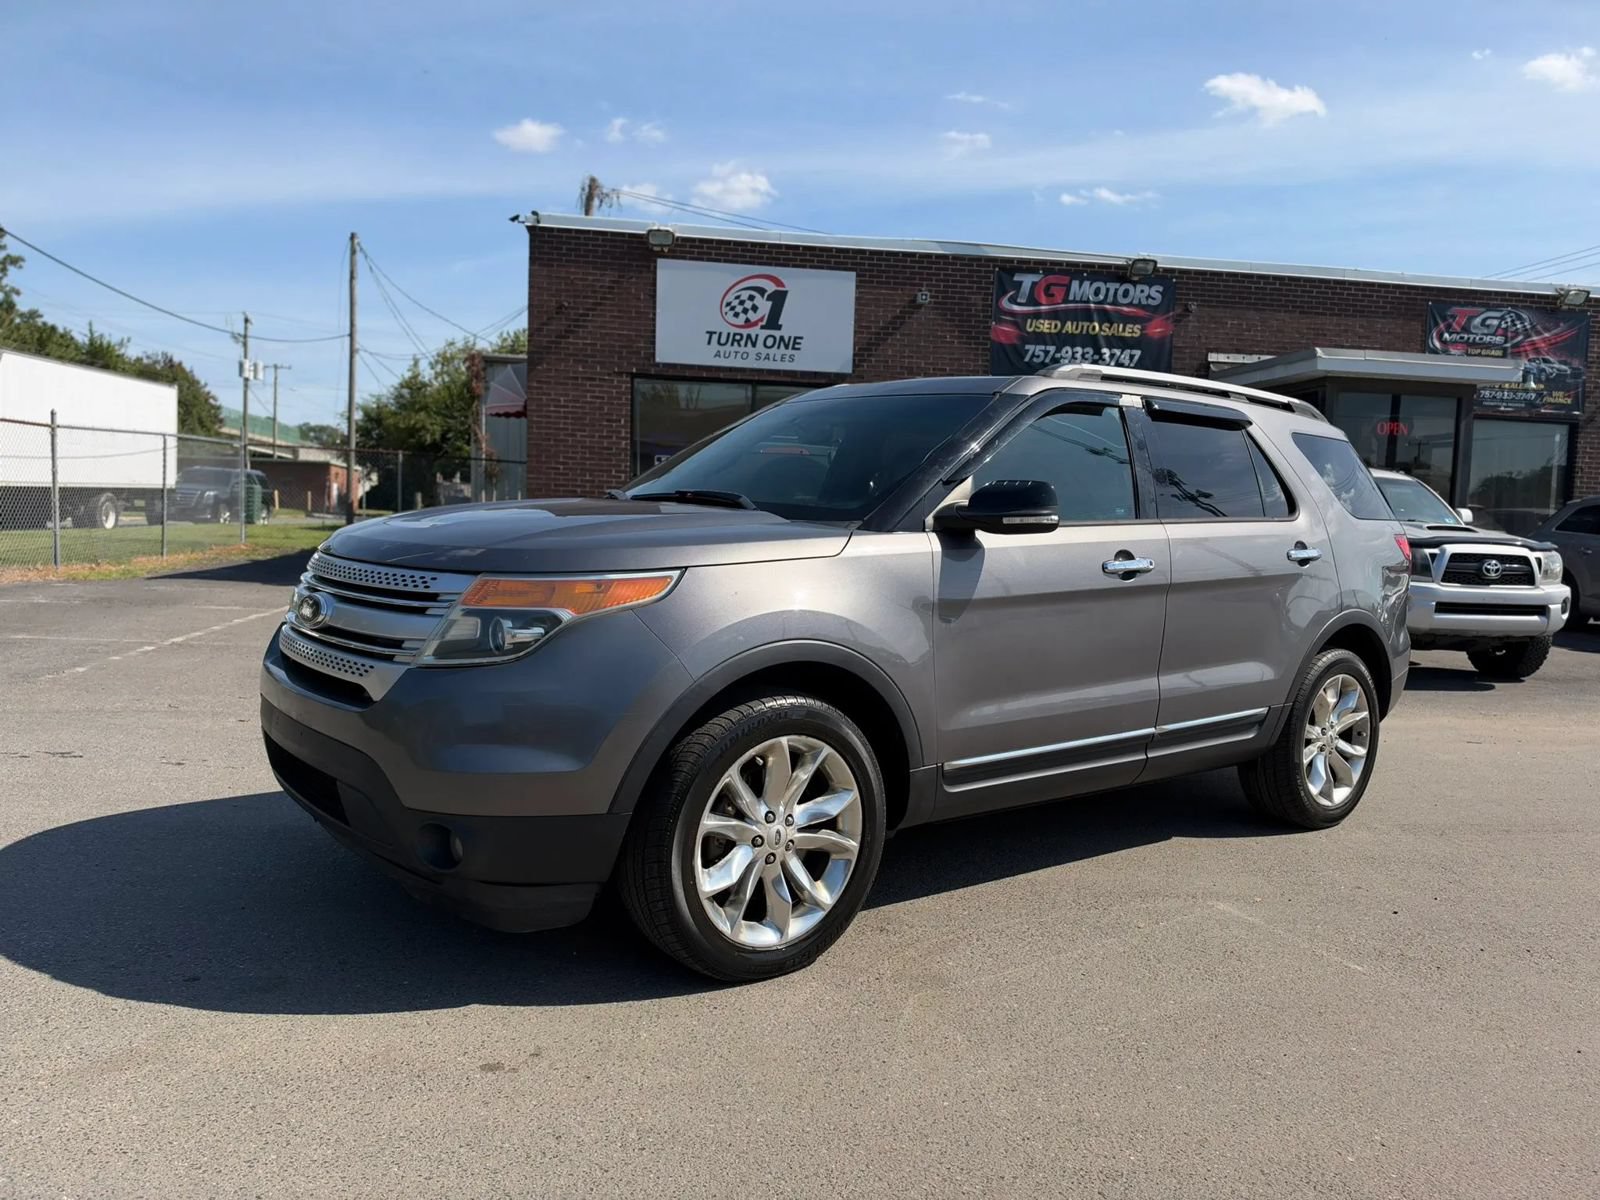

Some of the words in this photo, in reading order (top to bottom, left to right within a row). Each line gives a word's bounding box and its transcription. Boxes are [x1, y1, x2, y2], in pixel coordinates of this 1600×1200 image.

[1013, 273, 1071, 305] TG
[1068, 280, 1164, 306] MOTORS
[1026, 319, 1061, 333] USED
[1062, 320, 1099, 335] AUTO
[1100, 322, 1142, 337] SALES
[705, 330, 760, 349] TURN
[762, 334, 804, 351] ONE
[1442, 332, 1506, 344] MOTORS
[713, 350, 750, 361] AUTO
[755, 352, 796, 363] SALES
[1023, 344, 1142, 367] 757-933-3747
[1542, 396, 1573, 405] FINANCE
[1552, 390, 1565, 398] WE
[1376, 421, 1409, 437] OPEN
